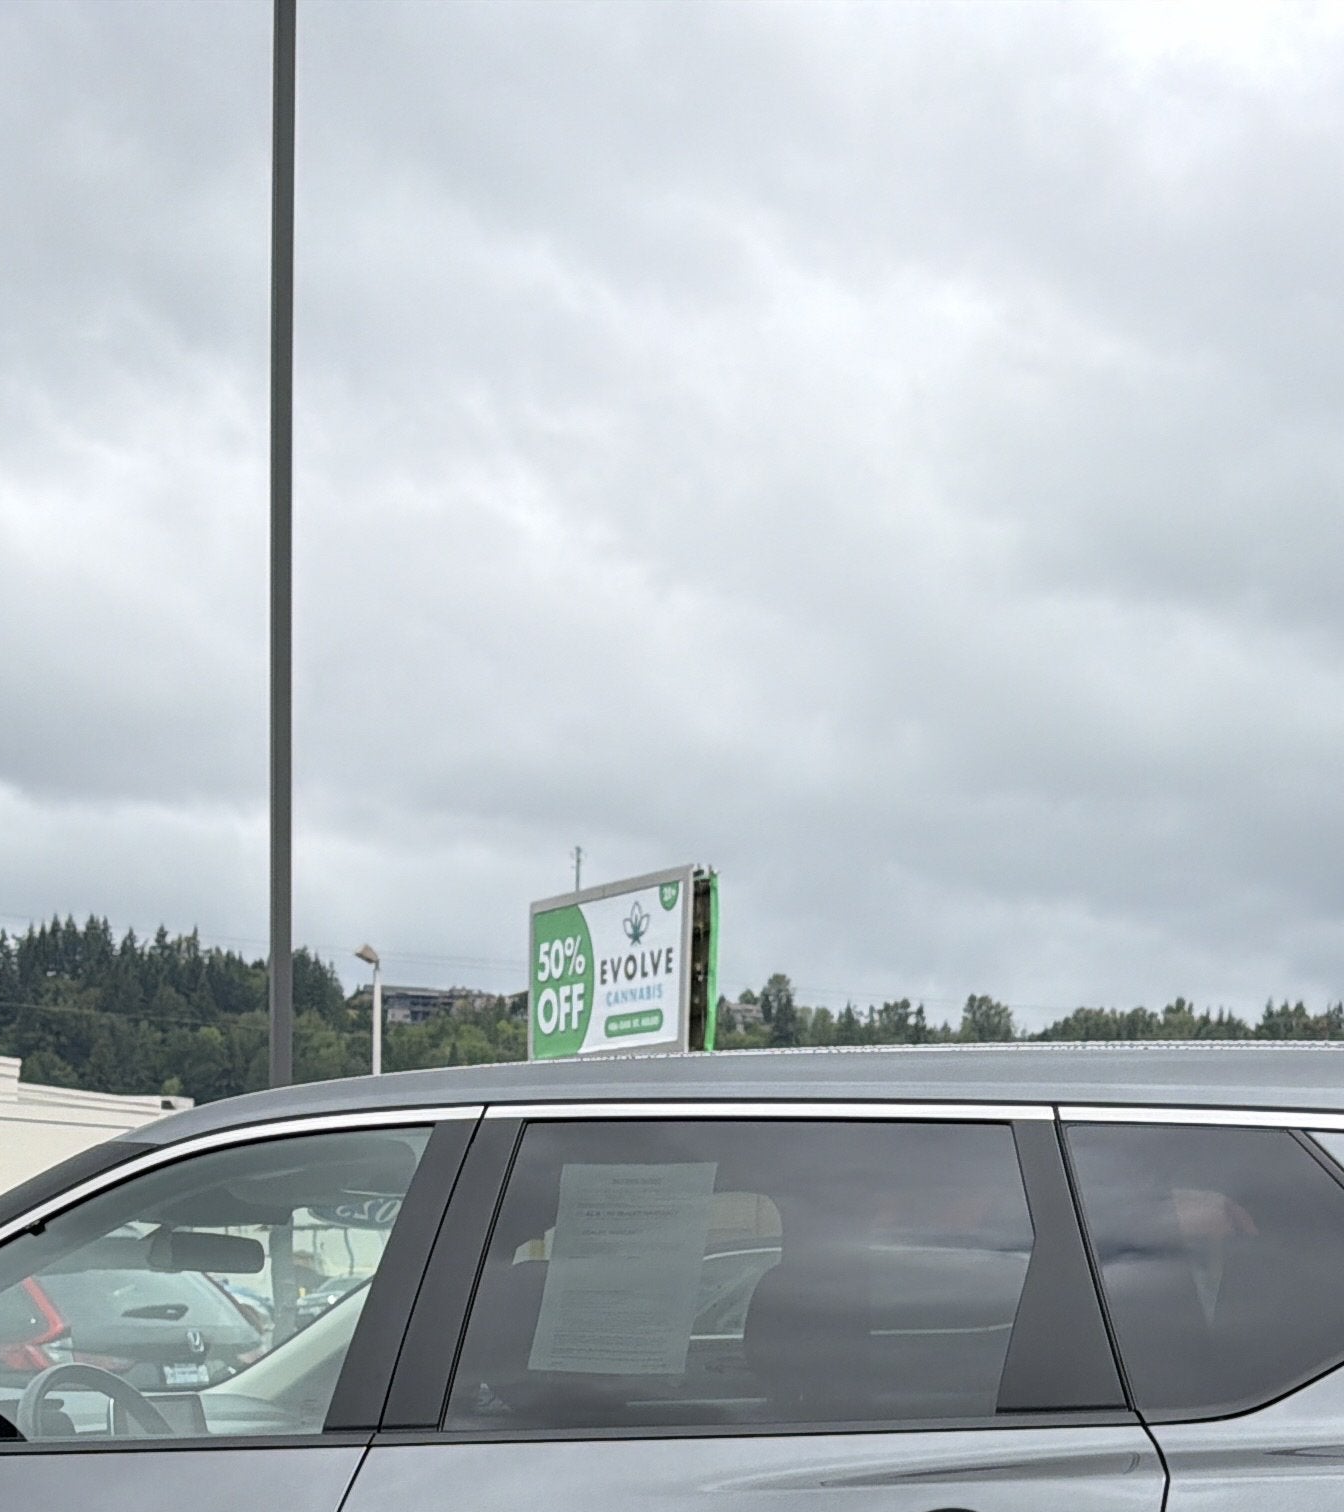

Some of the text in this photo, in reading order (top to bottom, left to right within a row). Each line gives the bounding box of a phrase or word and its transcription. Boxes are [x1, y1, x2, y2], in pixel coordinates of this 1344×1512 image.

[537, 934, 586, 983] 50%
[599, 946, 674, 986] EVOLVE
[537, 982, 585, 1035] OFF
[605, 983, 664, 1008] CANNABIS
